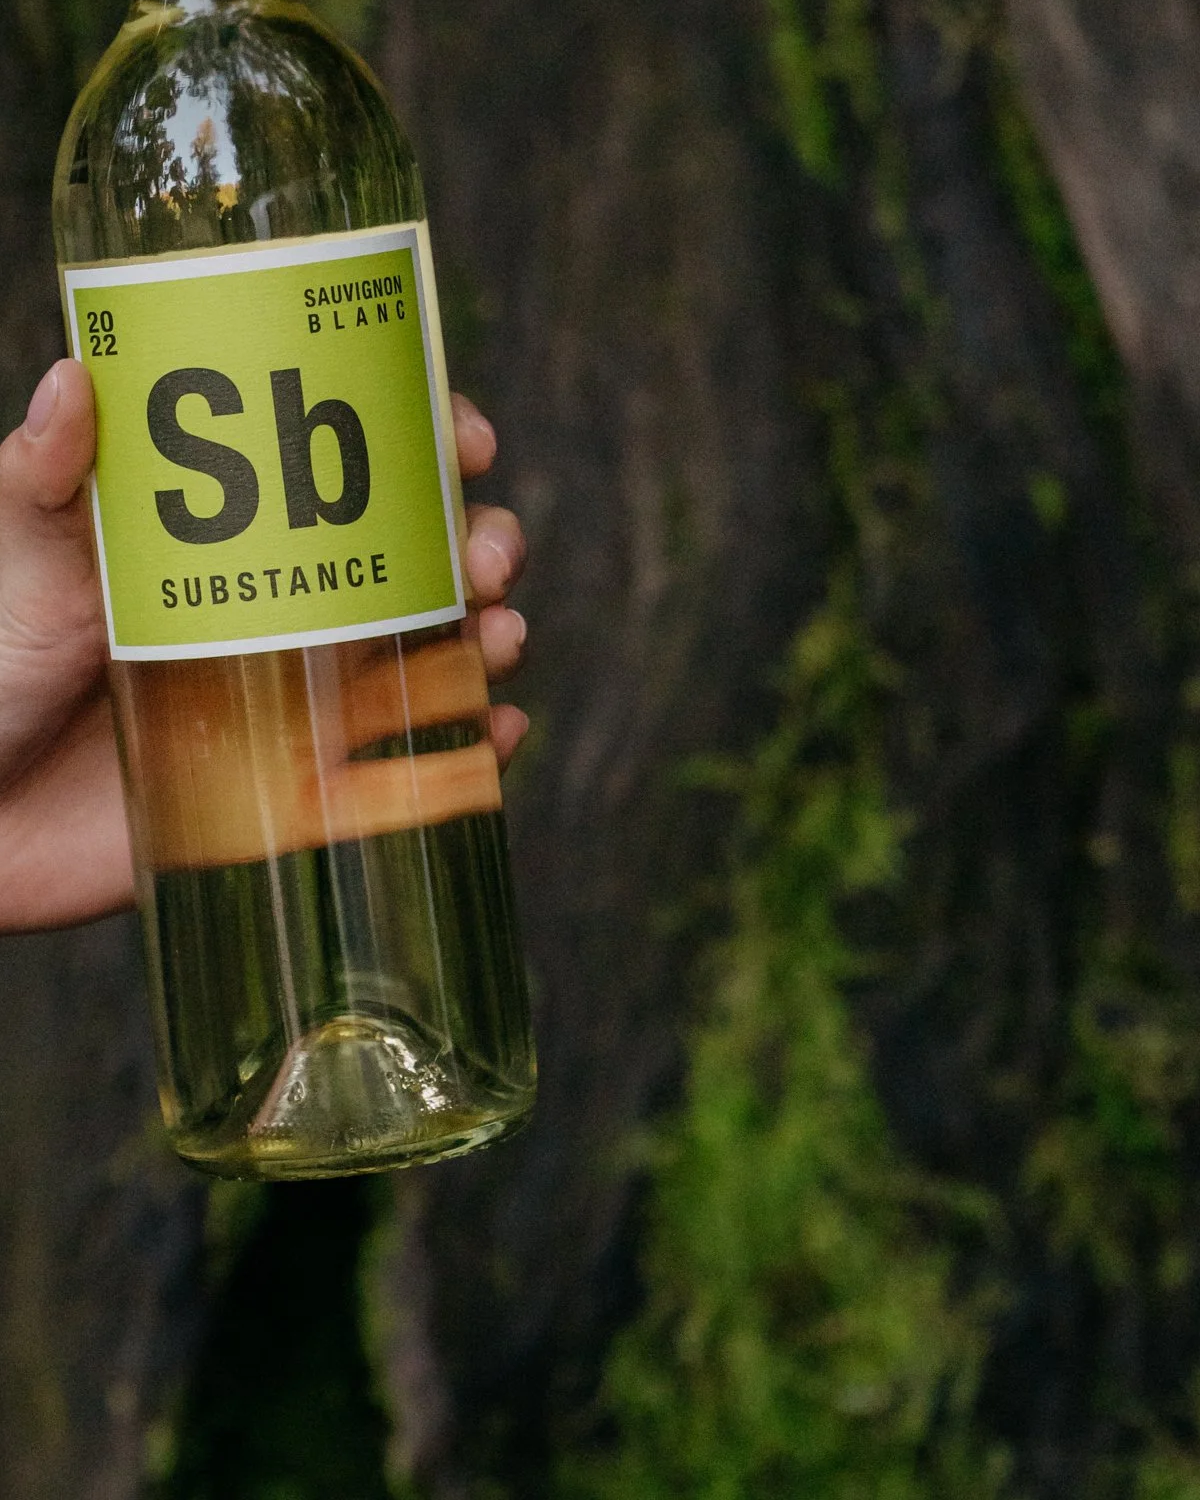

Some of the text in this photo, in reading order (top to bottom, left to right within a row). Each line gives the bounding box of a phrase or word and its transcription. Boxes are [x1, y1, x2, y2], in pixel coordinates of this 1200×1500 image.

[303, 275, 403, 308] SAUVIGNON
[87, 310, 114, 333] 20
[308, 300, 406, 334] BLANC
[89, 333, 118, 357] 22
[146, 367, 371, 545] Sb
[161, 553, 388, 609] SUBSTANCE
